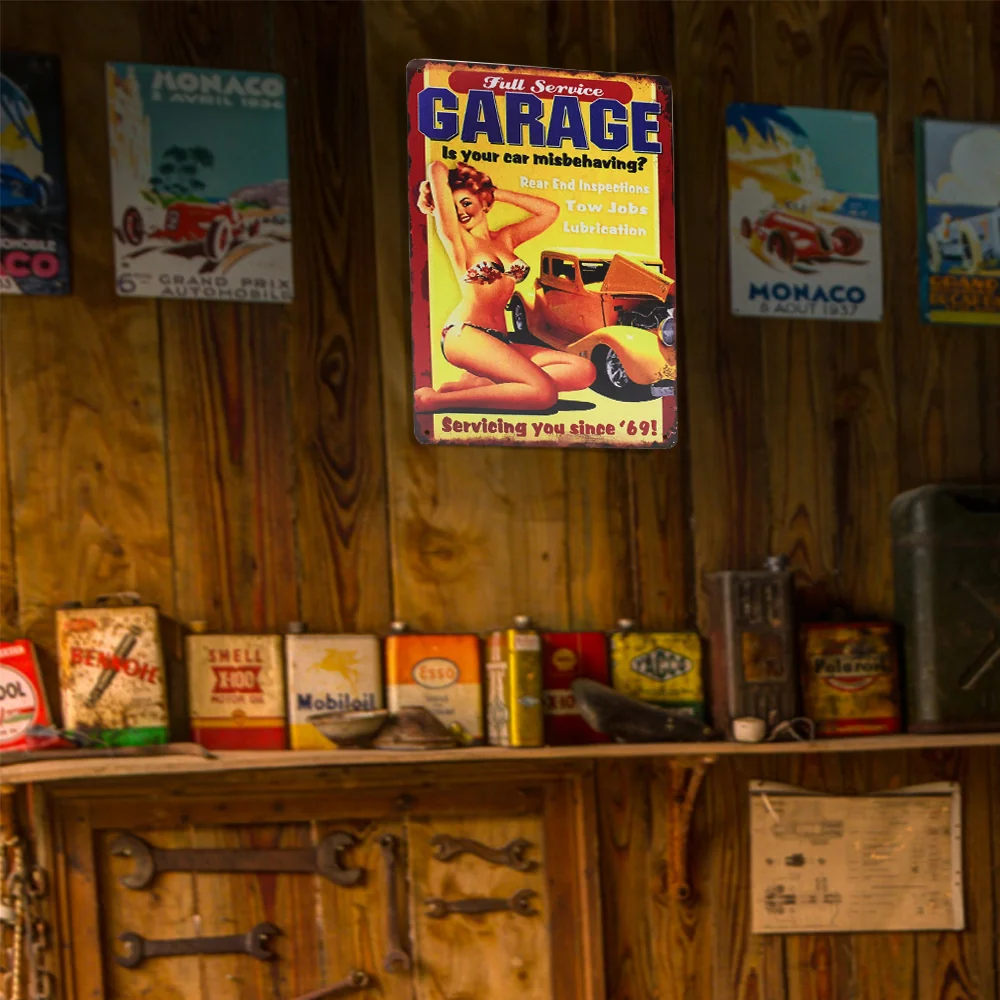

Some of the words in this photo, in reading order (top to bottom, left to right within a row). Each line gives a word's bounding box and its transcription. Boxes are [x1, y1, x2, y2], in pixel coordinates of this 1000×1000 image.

[152, 69, 284, 98] MONACO
[483, 75, 525, 92] Full
[530, 79, 605, 98] Service
[417, 86, 663, 154] GARAGE
[442, 146, 457, 160] Is
[460, 149, 499, 164] your
[503, 152, 530, 166] car
[533, 152, 648, 174] misbehaving?
[520, 175, 549, 189] Rear
[552, 176, 576, 191] End
[578, 179, 650, 195] Inspections
[566, 199, 603, 213] Tow
[607, 200, 649, 216] Jobs
[563, 221, 647, 237] Lubrication
[0, 251, 60, 278] CO
[159, 274, 229, 288] GRAND
[240, 278, 290, 291] PRIX
[748, 281, 866, 305] MONACO
[775, 303, 817, 316] AOUT
[441, 416, 527, 437] Servicing
[532, 420, 565, 437] you
[569, 419, 616, 436] since
[208, 648, 263, 663] SHELL
[419, 667, 455, 680] Esso
[296, 692, 376, 712] Mobiloil
